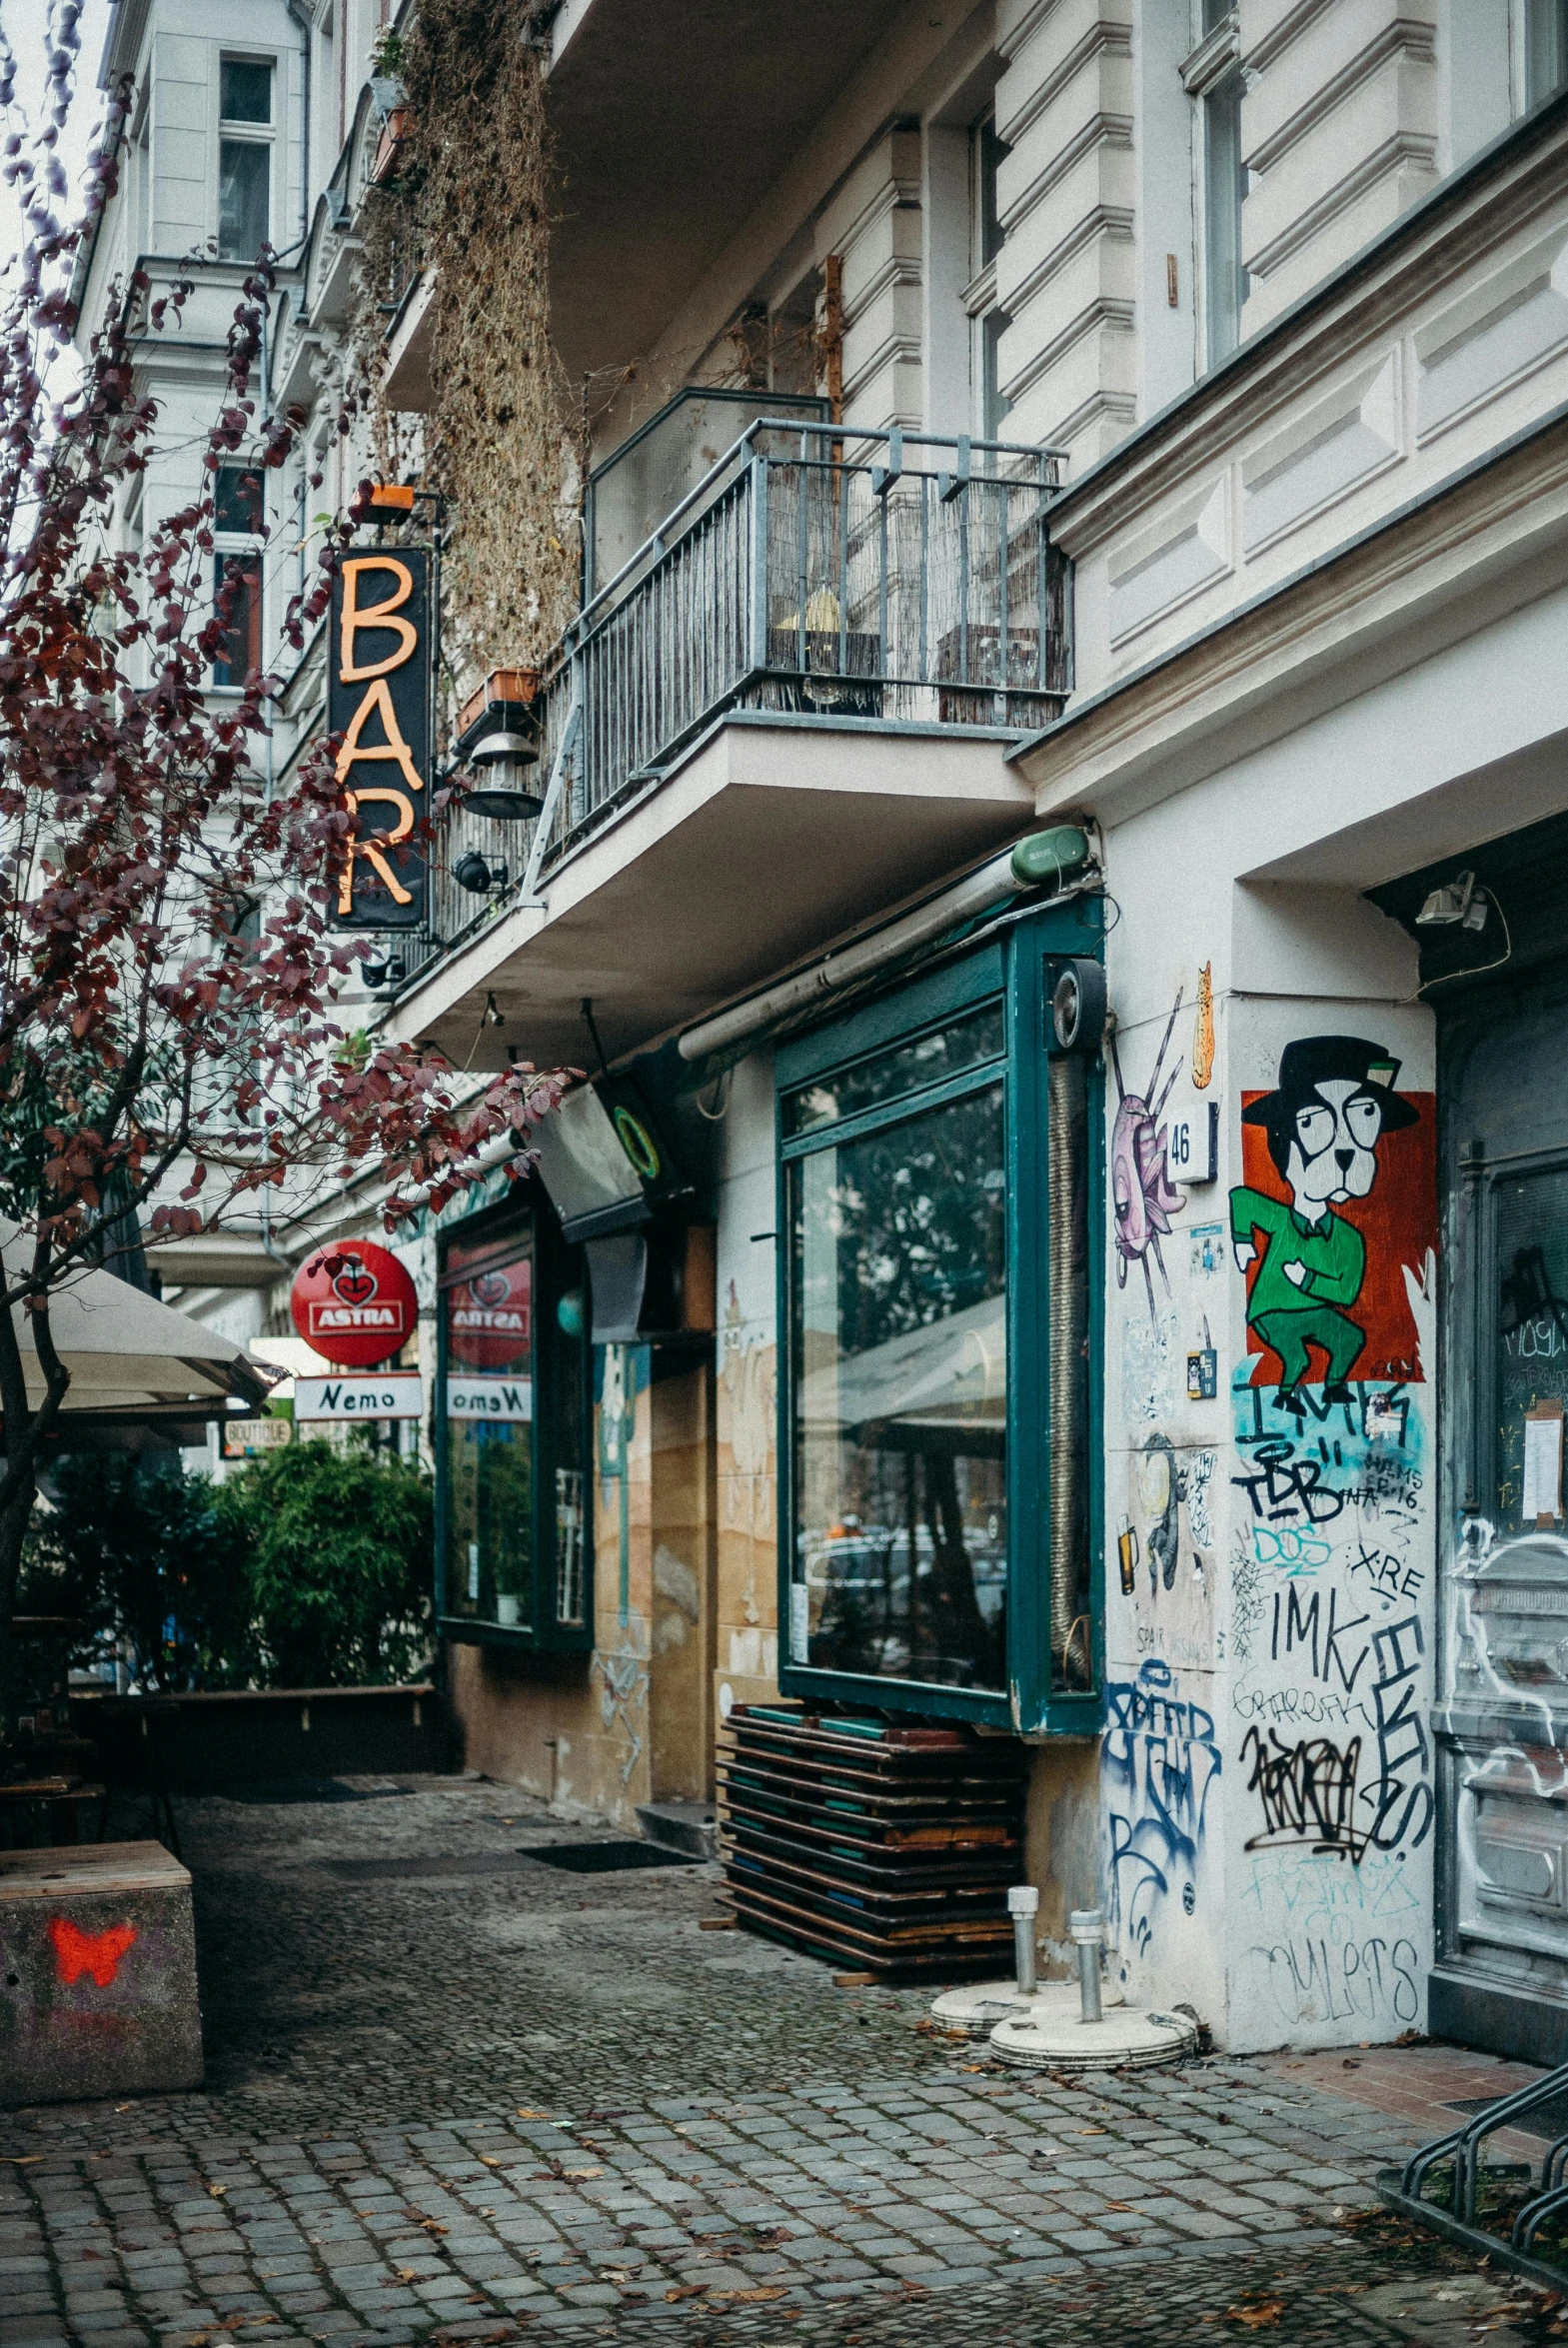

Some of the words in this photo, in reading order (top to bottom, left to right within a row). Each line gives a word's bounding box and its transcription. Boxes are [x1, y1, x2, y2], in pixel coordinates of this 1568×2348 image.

[336, 556, 424, 915] BAR
[1172, 1123, 1189, 1167] 46
[318, 1307, 395, 1327] ASTRA
[319, 1383, 395, 1410] Nemo
